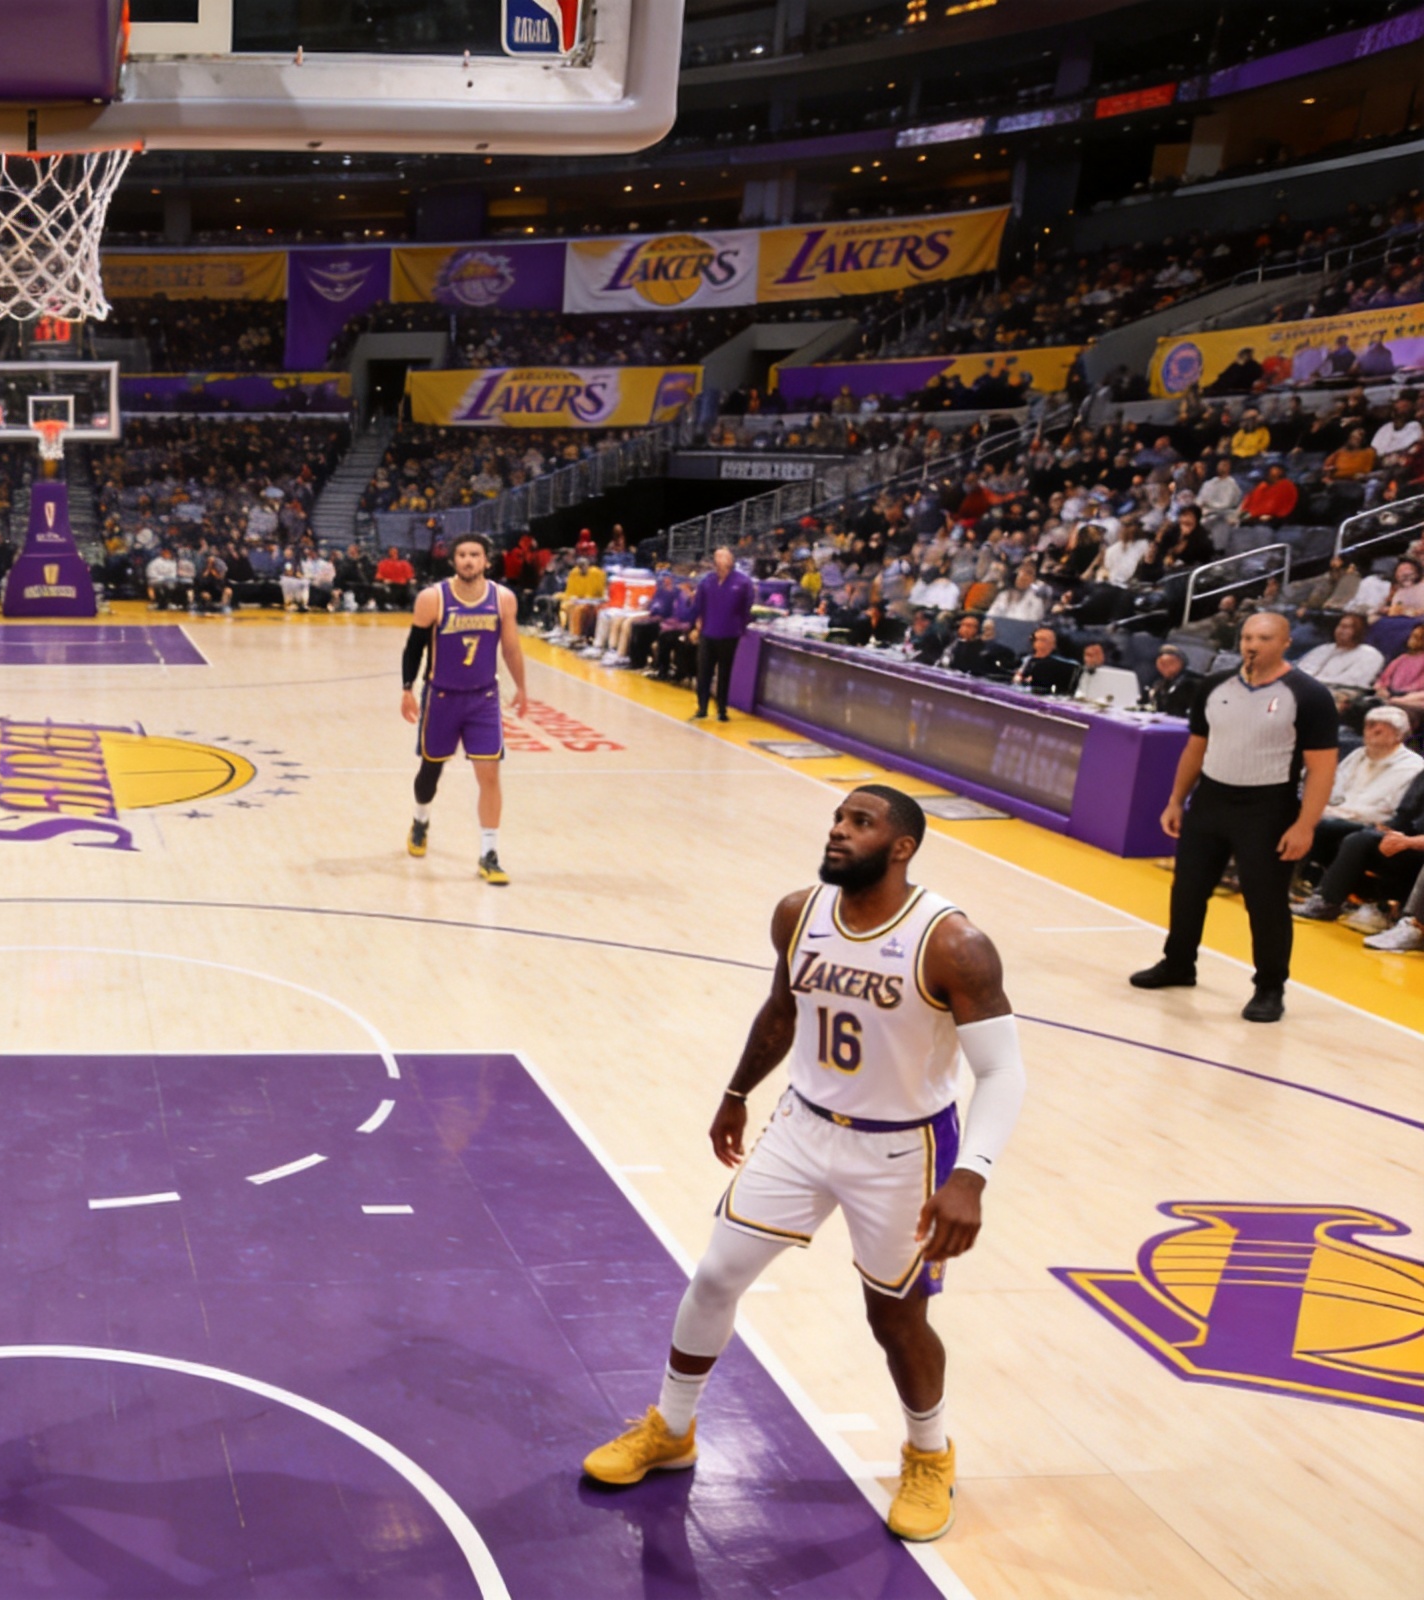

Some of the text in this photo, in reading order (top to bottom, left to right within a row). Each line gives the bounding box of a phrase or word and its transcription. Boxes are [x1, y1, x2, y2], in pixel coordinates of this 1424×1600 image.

[602, 240, 739, 291] LAKERS
[774, 229, 954, 285] LAKERS
[453, 370, 607, 423] LAKERS
[461, 635, 480, 667] 7
[790, 949, 904, 1010] LAKERS
[817, 1005, 863, 1076] 16
